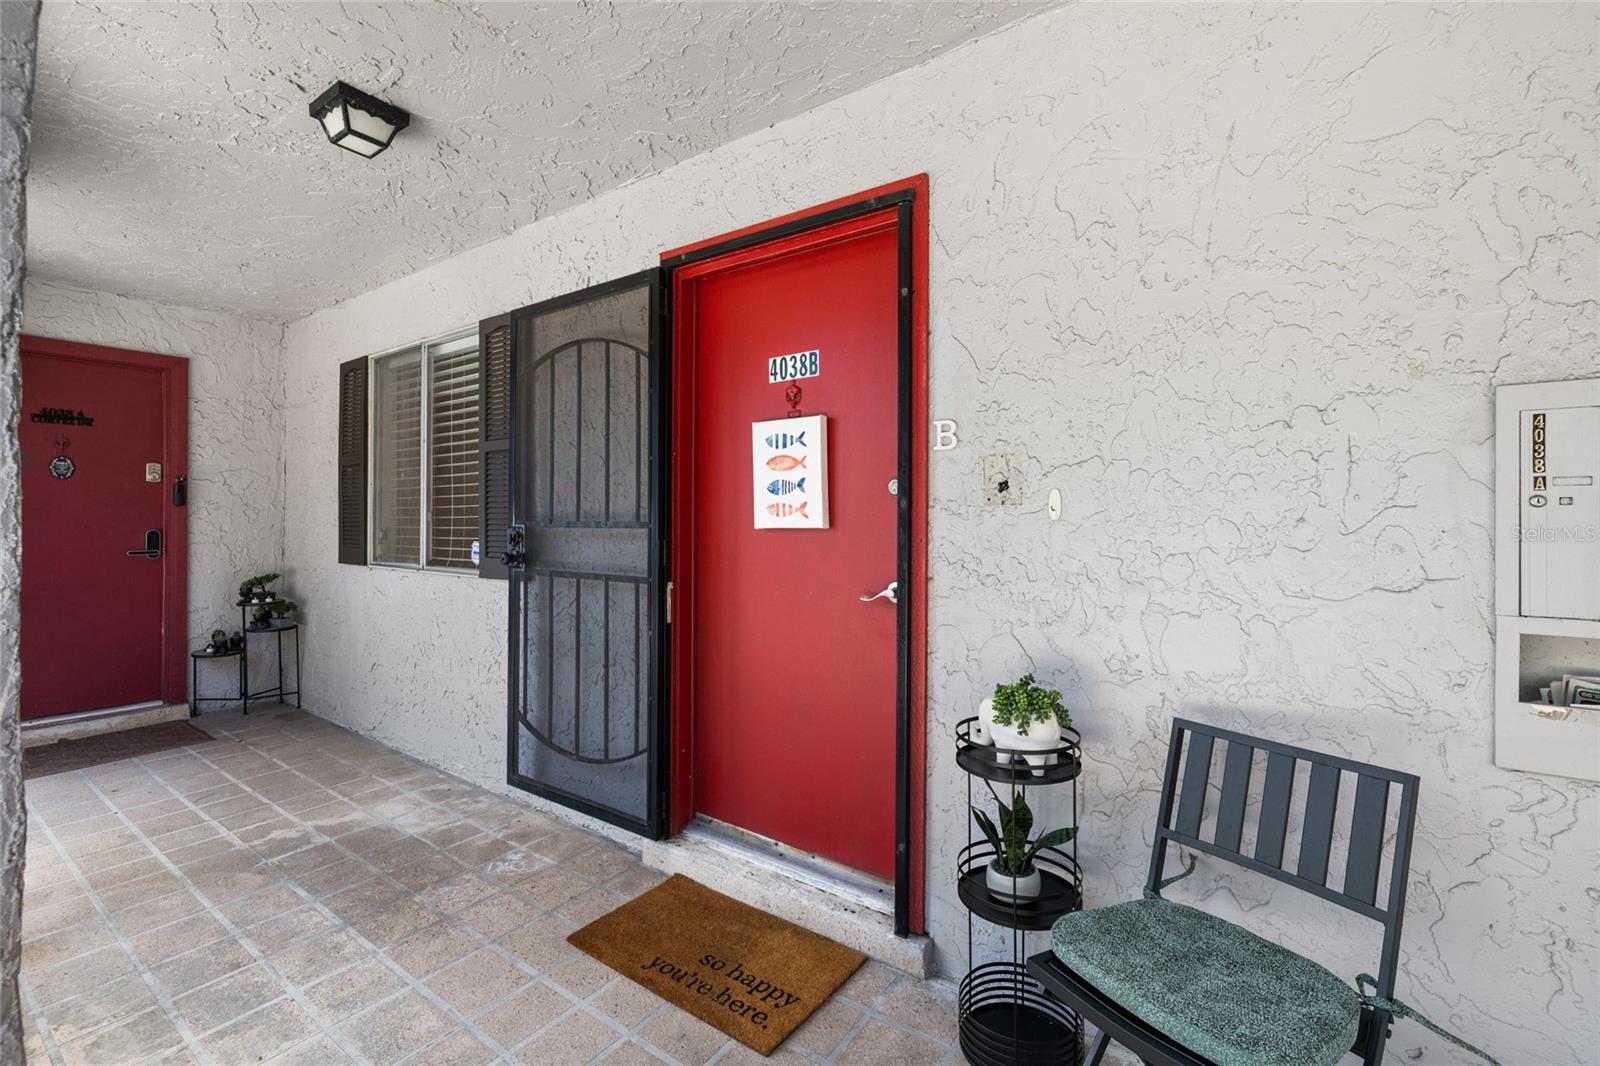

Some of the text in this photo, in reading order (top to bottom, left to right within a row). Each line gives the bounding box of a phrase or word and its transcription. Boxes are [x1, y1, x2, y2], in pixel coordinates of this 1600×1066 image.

[770, 351, 818, 381] 4038B
[933, 419, 959, 450] B
[1533, 414, 1545, 473] 4038
[640, 956, 769, 1029] you're here.
[698, 954, 802, 1009] so happy
